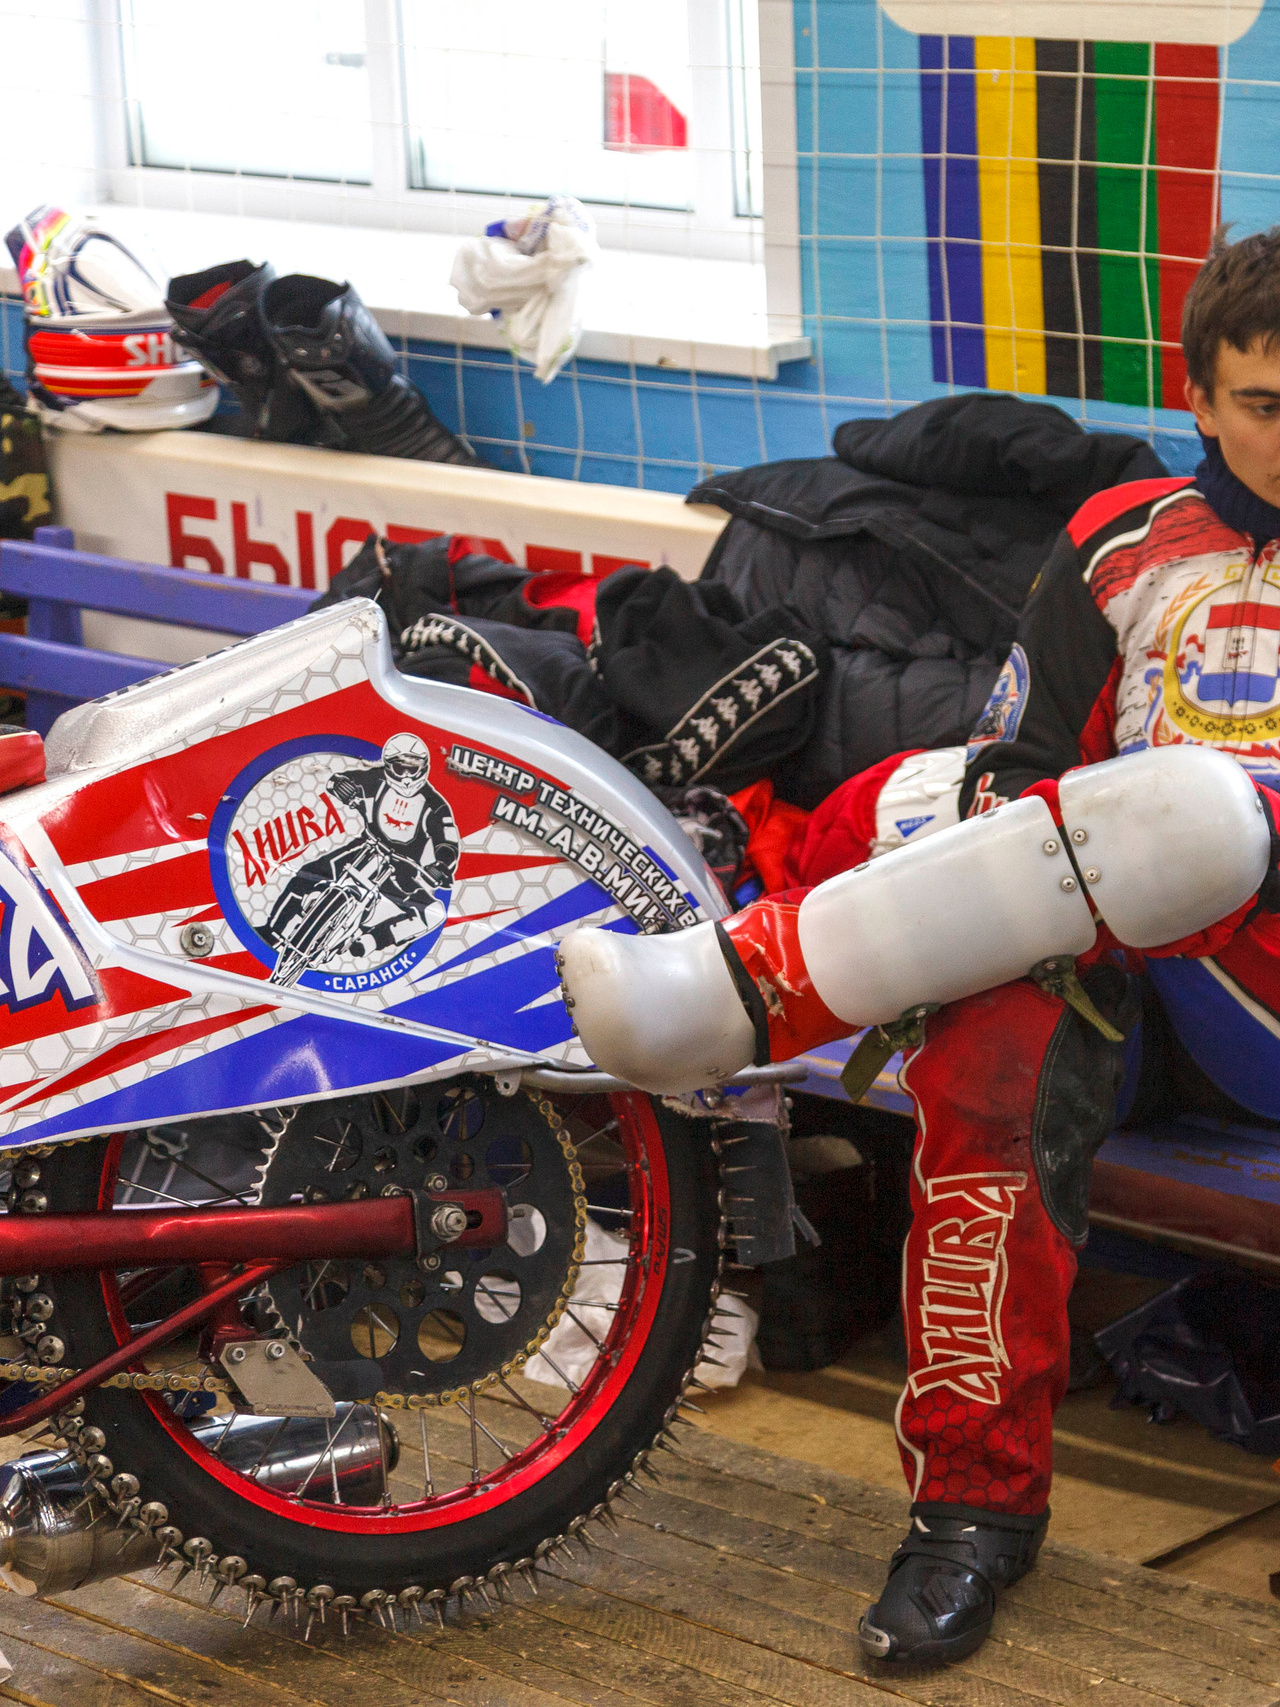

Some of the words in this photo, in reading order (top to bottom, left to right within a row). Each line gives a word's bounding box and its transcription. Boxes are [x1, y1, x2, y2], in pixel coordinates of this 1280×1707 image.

[231, 791, 346, 888] АНИВА
[450, 747, 536, 794] ЦЕНТР
[535, 780, 686, 915] ТЕХНИЧЕСКИХ
[493, 796, 546, 838] ИМ.
[332, 956, 415, 991] САРАНСК
